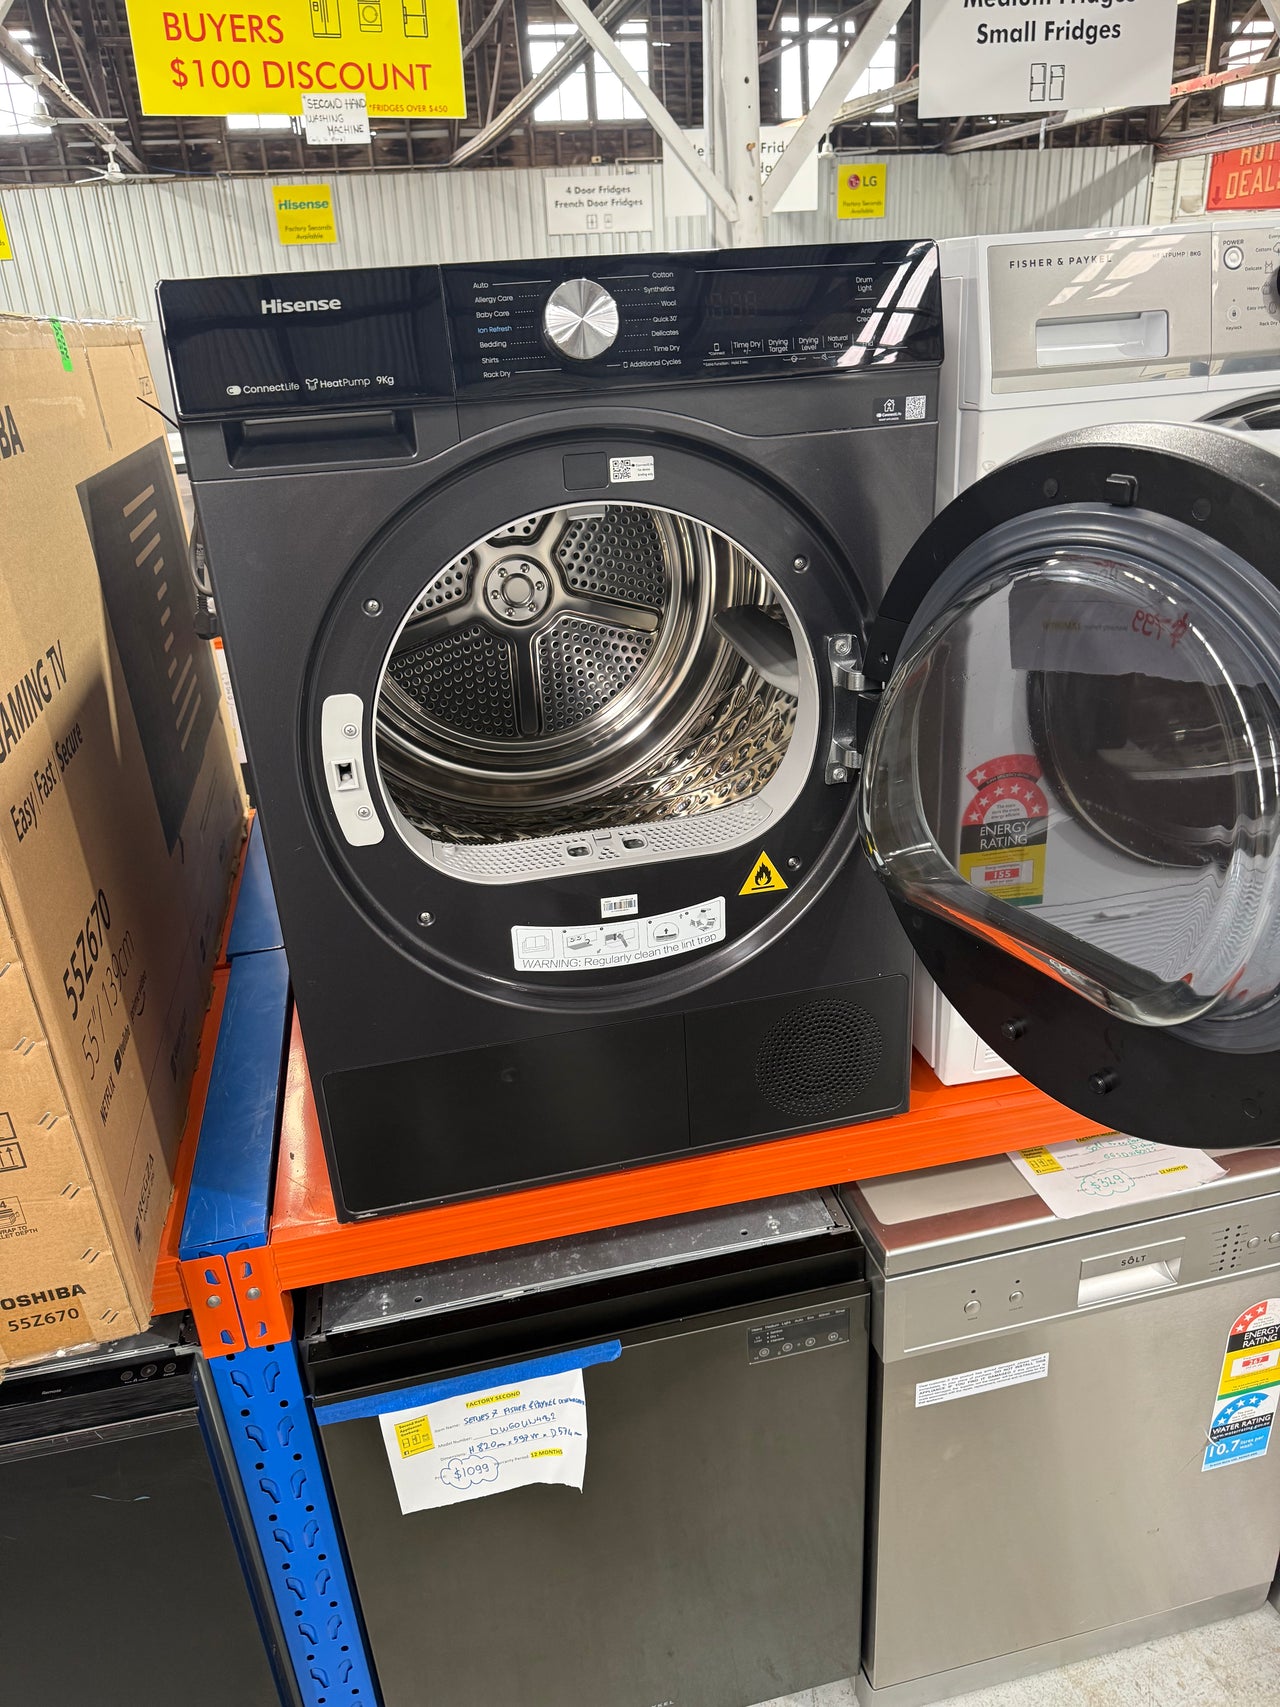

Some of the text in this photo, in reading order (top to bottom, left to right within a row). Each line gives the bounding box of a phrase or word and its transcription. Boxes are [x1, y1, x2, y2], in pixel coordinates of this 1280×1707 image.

[164, 12, 284, 43] BUYERS
[976, 18, 1121, 45] Small Fridges
[171, 56, 432, 92] $100 DISCOUNT
[307, 97, 367, 110] SECOND HAND
[406, 104, 426, 113] OVER
[429, 104, 448, 113] $450
[307, 113, 344, 123] WASHING
[327, 124, 364, 136] MACHINE
[862, 175, 878, 188] LG
[566, 184, 631, 195] 4 Door Fridges
[278, 199, 329, 210] Hisense
[555, 198, 643, 209] French Door Fridges
[1010, 253, 1112, 269] FISHER & PAYKEL
[651, 271, 674, 279] Cotton
[855, 276, 873, 284] Drum
[643, 285, 675, 294] Synthetics
[475, 296, 496, 304] Allergy
[660, 299, 676, 307] Wool
[261, 297, 341, 315] Hisense
[476, 311, 493, 319] Baby
[489, 325, 512, 333] Refresh
[479, 340, 507, 349] Bedding
[733, 340, 761, 349] Time Dry
[768, 339, 789, 347] Drying
[798, 337, 819, 346] Drying
[833, 341, 844, 349] Dry
[669, 344, 681, 352] Dry
[481, 356, 499, 364] Shirts
[629, 358, 682, 368] Additional Cycles
[499, 370, 511, 378] Dry
[243, 375, 395, 394] ConnectLife HeatPump 9Kg
[46, 639, 67, 691] TV
[10, 721, 83, 843] Easy Fast Secure
[980, 821, 1031, 836] ENERGY
[980, 834, 1028, 850] RATING
[992, 869, 1011, 879] 155
[62, 888, 111, 1022] 55Z670
[522, 933, 717, 970] WARNING: Regularly clean the lint trap
[15, 1227, 39, 1237] DEPTH
[8, 1307, 80, 1333] 55Z670
[1244, 1326, 1280, 1340] ENERGY
[1243, 1334, 1278, 1348] RATING
[465, 1390, 521, 1408] FACTORY SECOND
[1212, 1423, 1240, 1435] WATER
[1241, 1414, 1272, 1427] RATING
[538, 1448, 564, 1456] MONTHS
[1209, 1439, 1240, 1457] 10.7
[453, 1463, 490, 1482] $1099
